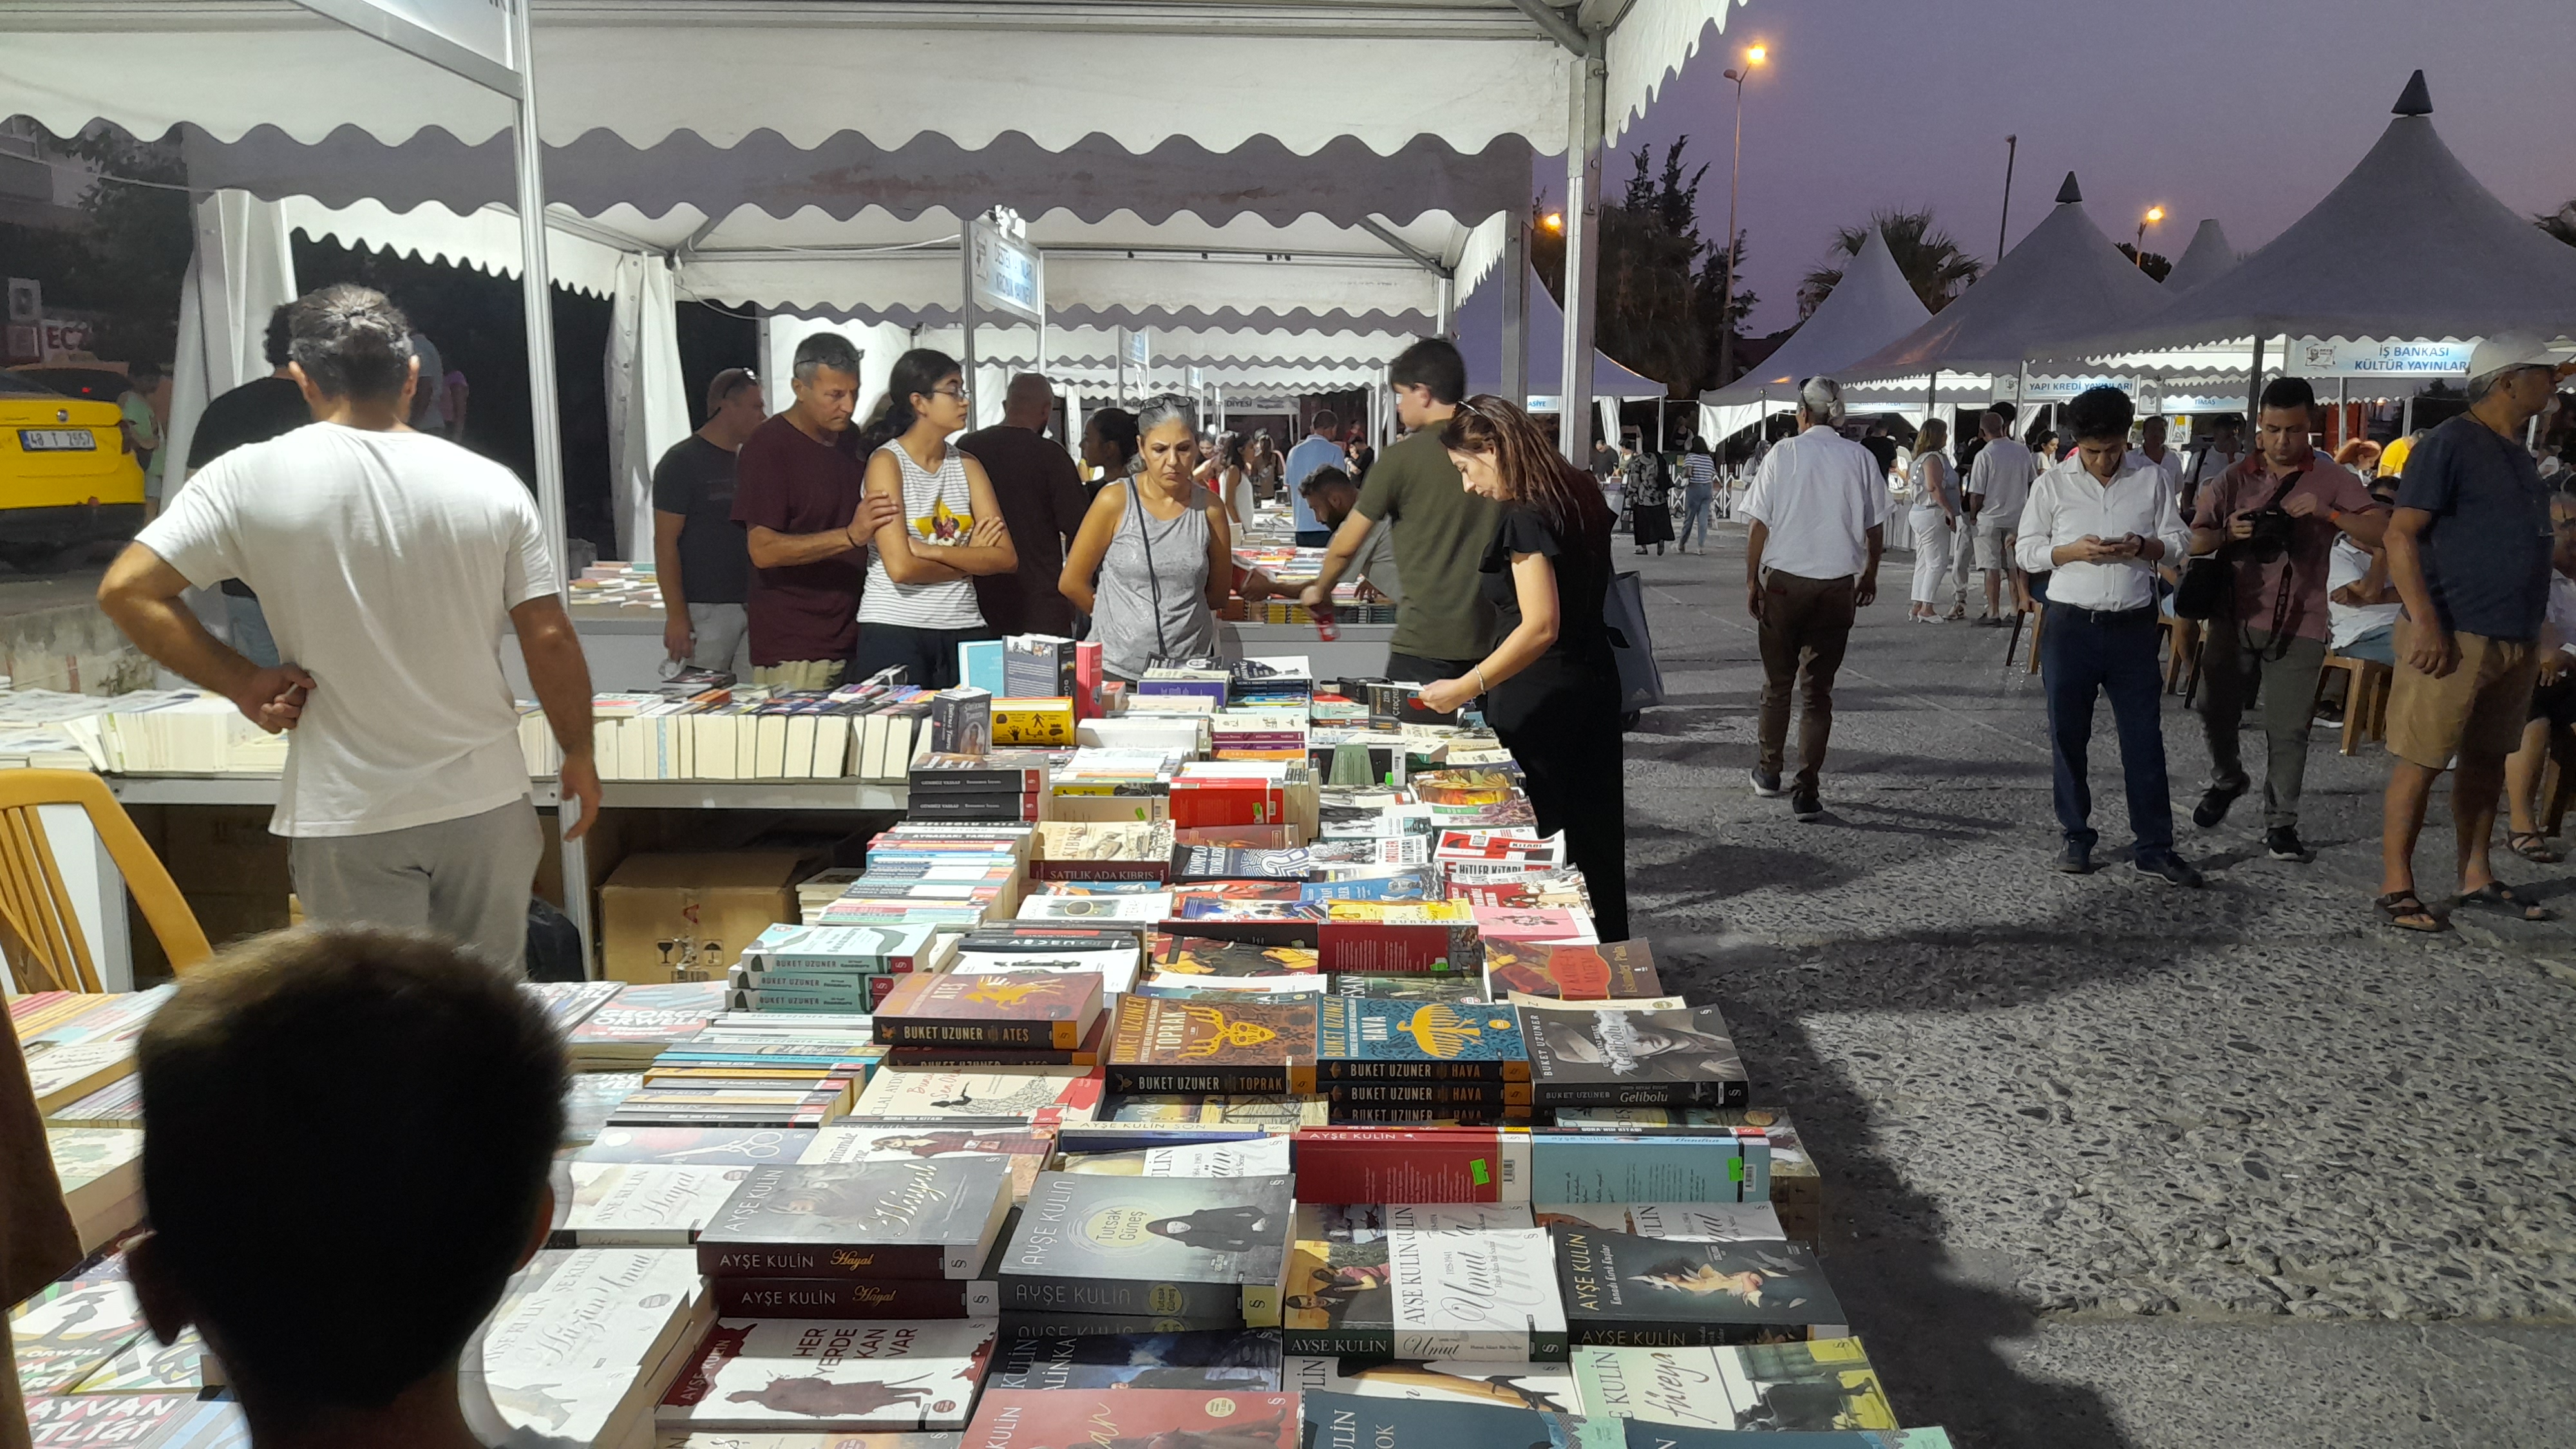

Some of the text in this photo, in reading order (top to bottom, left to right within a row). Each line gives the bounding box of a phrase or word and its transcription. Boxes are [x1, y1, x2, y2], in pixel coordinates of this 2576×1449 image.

[2354, 359, 2403, 370] KÜLTÜR
[2379, 344, 2448, 358] İŞ BANKASI
[2053, 381, 2081, 390] KREDİ
[1188, 846, 1208, 875] KOMPLO
[1459, 863, 1489, 874] HİTLER
[1050, 871, 1154, 880] SATILIK ADA KIBRIS
[598, 1009, 711, 1018] GEORGE
[1323, 996, 1345, 1057] BUKET UZUNER
[1361, 1016, 1388, 1040] HAVA
[904, 1026, 1029, 1043] BUKET UZUNER ATEŞ
[1113, 996, 1148, 1063] BUKET UZUNER
[1155, 1012, 1186, 1051] TOPRAK
[1530, 1014, 1553, 1076] BUKET UZUNER
[1604, 1025, 1633, 1066] Gelibolu
[1138, 1076, 1282, 1091] BUKET UZUNER TOPRAK
[1350, 1064, 1480, 1077] BUKET UZUNER HAVA
[1351, 1087, 1481, 1101] BUKET UZUNER HAVA
[1620, 1092, 1669, 1103] Gelibolu
[723, 1168, 784, 1232] AYŞE KULİN
[1021, 1179, 1076, 1266] AYŞE KULİN
[1095, 1209, 1124, 1242] Tutsak
[1119, 1210, 1148, 1241] Güneş
[719, 1249, 875, 1272] AYŞE KULİN Hayal
[1564, 1233, 1600, 1311] AYŞE KULİN
[741, 1285, 897, 1307] AYŞE KULİN Hayal
[1015, 1284, 1130, 1306] AYŞE KULİN
[1394, 1243, 1429, 1325] AYŞE KULİN
[1441, 1251, 1496, 1322] Umut
[792, 1328, 828, 1358] HER
[853, 1329, 889, 1359] KAN
[885, 1328, 918, 1358] VAR
[1291, 1338, 1388, 1353] AYŞE KULİN
[1403, 1335, 1459, 1356] Umut
[1581, 1331, 1626, 1345] AYŞE
[1634, 1329, 1685, 1345] KULİN
[26, 1348, 103, 1358] ORWELL
[815, 1328, 858, 1377] YERDE
[1001, 1339, 1039, 1389] KULİN
[680, 1339, 733, 1402] AYŞE KULİN
[1591, 1350, 1630, 1403] KULİN
[24, 1397, 180, 1420] AYVAN
[986, 1406, 1023, 1449] KULİN
